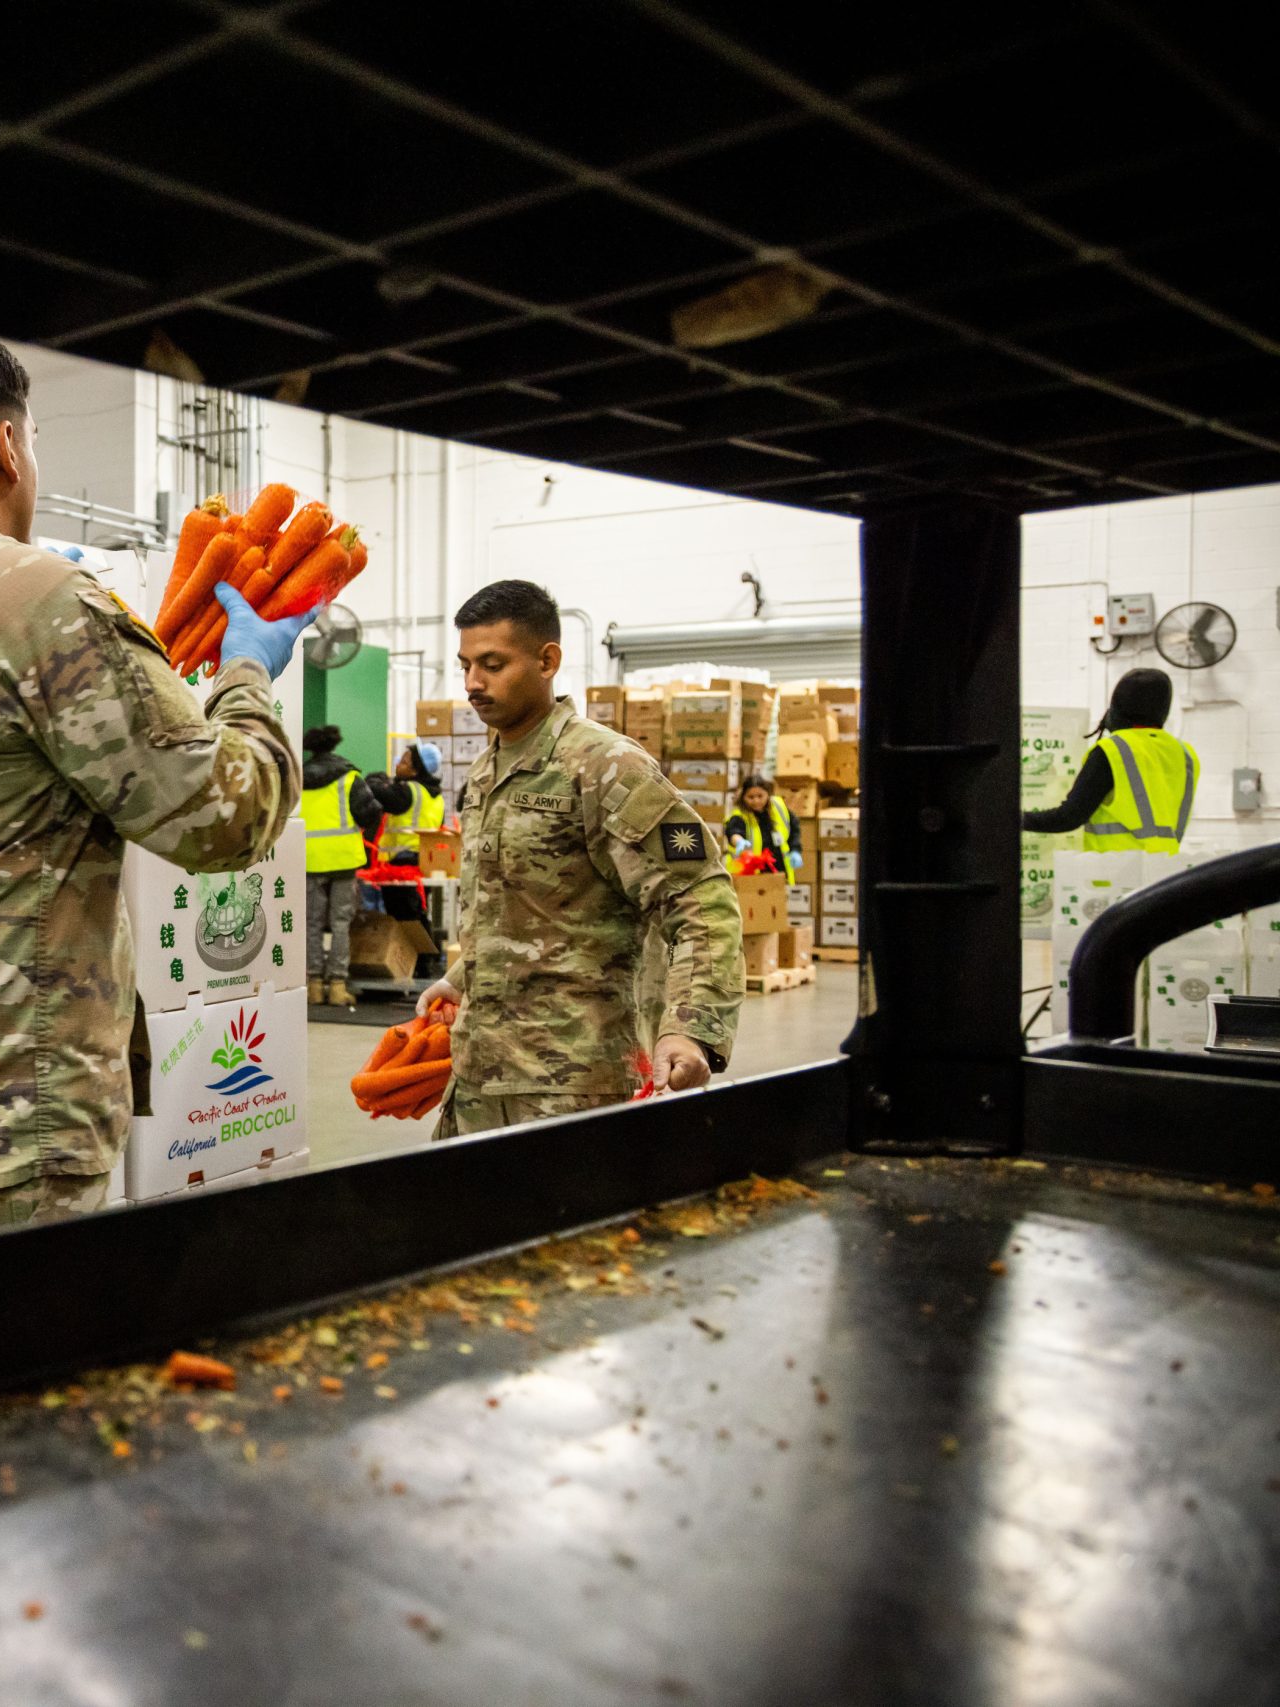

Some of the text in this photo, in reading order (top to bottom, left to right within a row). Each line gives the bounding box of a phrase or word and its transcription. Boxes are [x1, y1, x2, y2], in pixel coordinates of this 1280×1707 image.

[534, 796, 562, 809] ARMY
[206, 975, 251, 989] PREMIUM BROCCOLI
[187, 1089, 287, 1124] Pacific Coast Produce
[168, 1103, 296, 1160] California BROCCOLI
